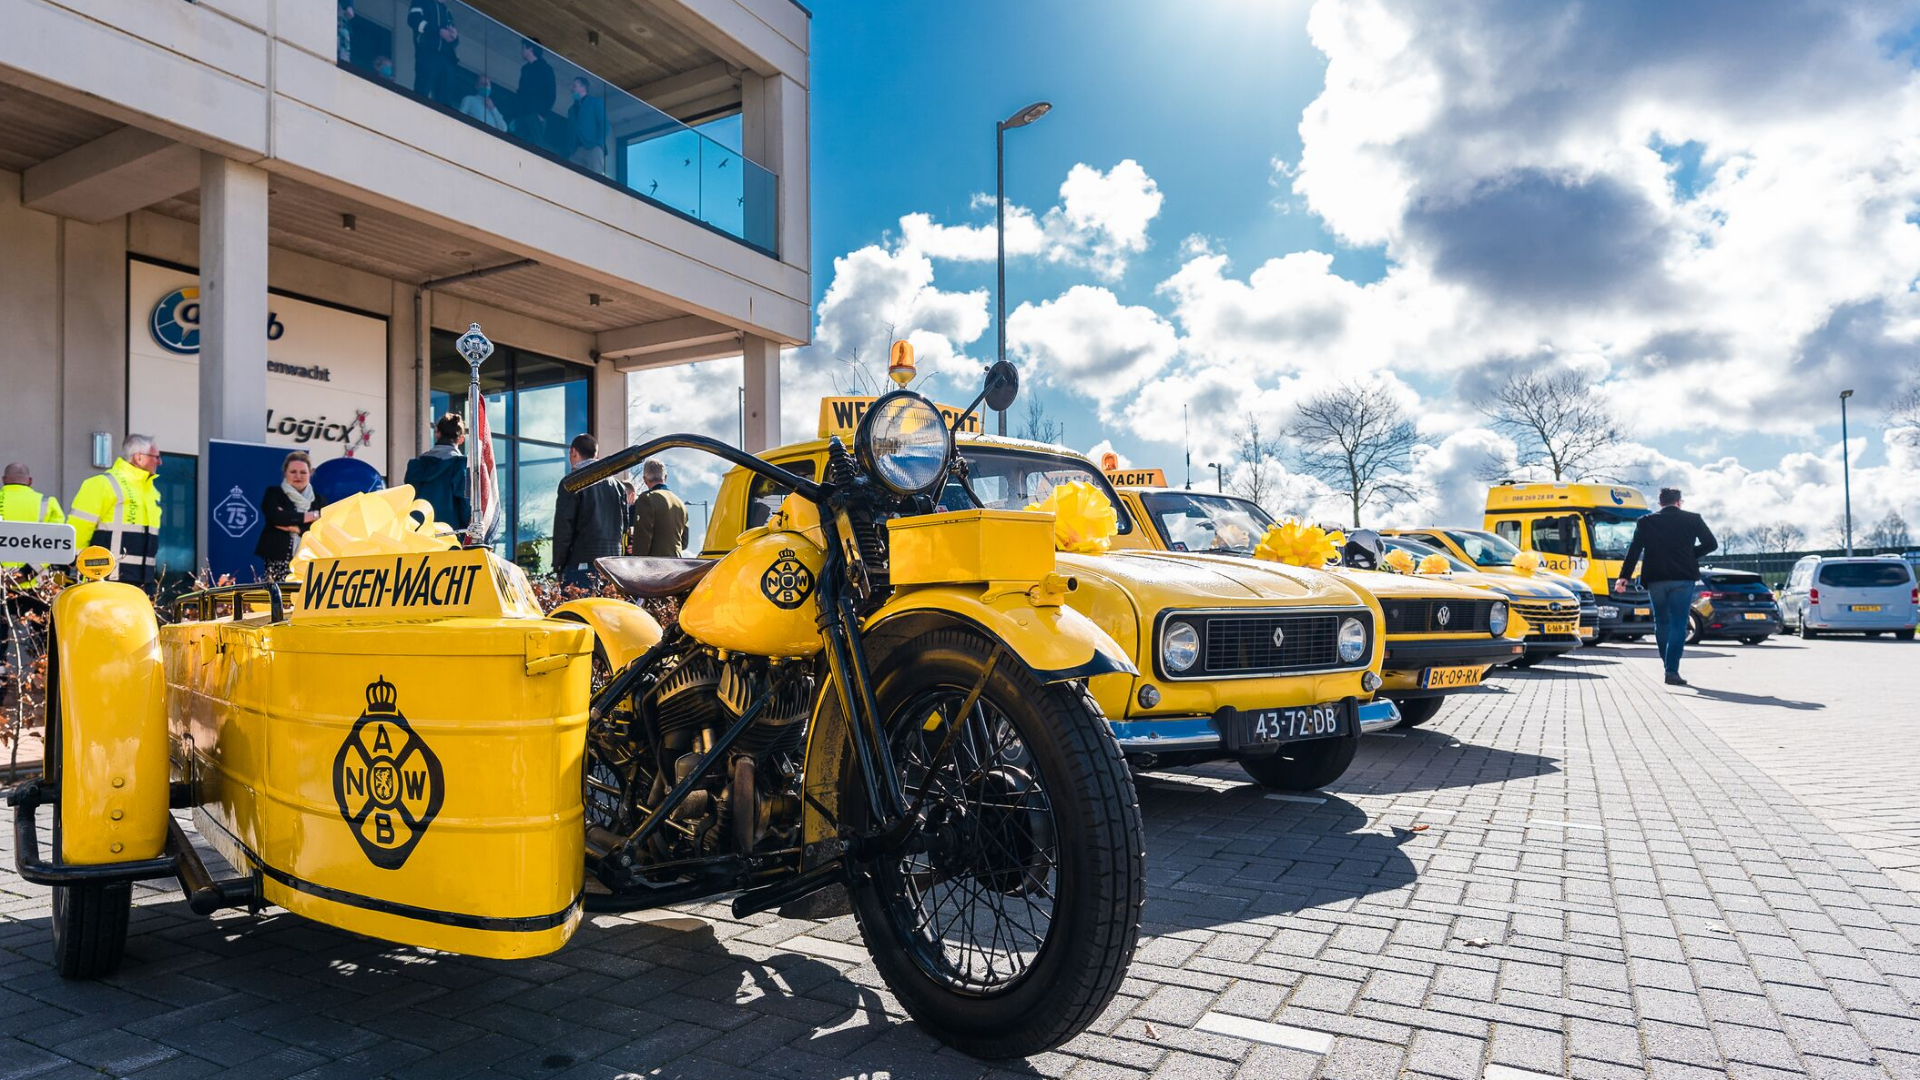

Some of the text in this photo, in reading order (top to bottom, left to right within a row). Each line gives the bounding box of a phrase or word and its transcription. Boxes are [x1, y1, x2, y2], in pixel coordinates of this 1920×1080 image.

[226, 507, 247, 525] 75
[303, 555, 483, 610] WEGEN-WACHT
[1431, 669, 1480, 686] BK-09-RK
[1255, 708, 1337, 739] 43-72-DB
